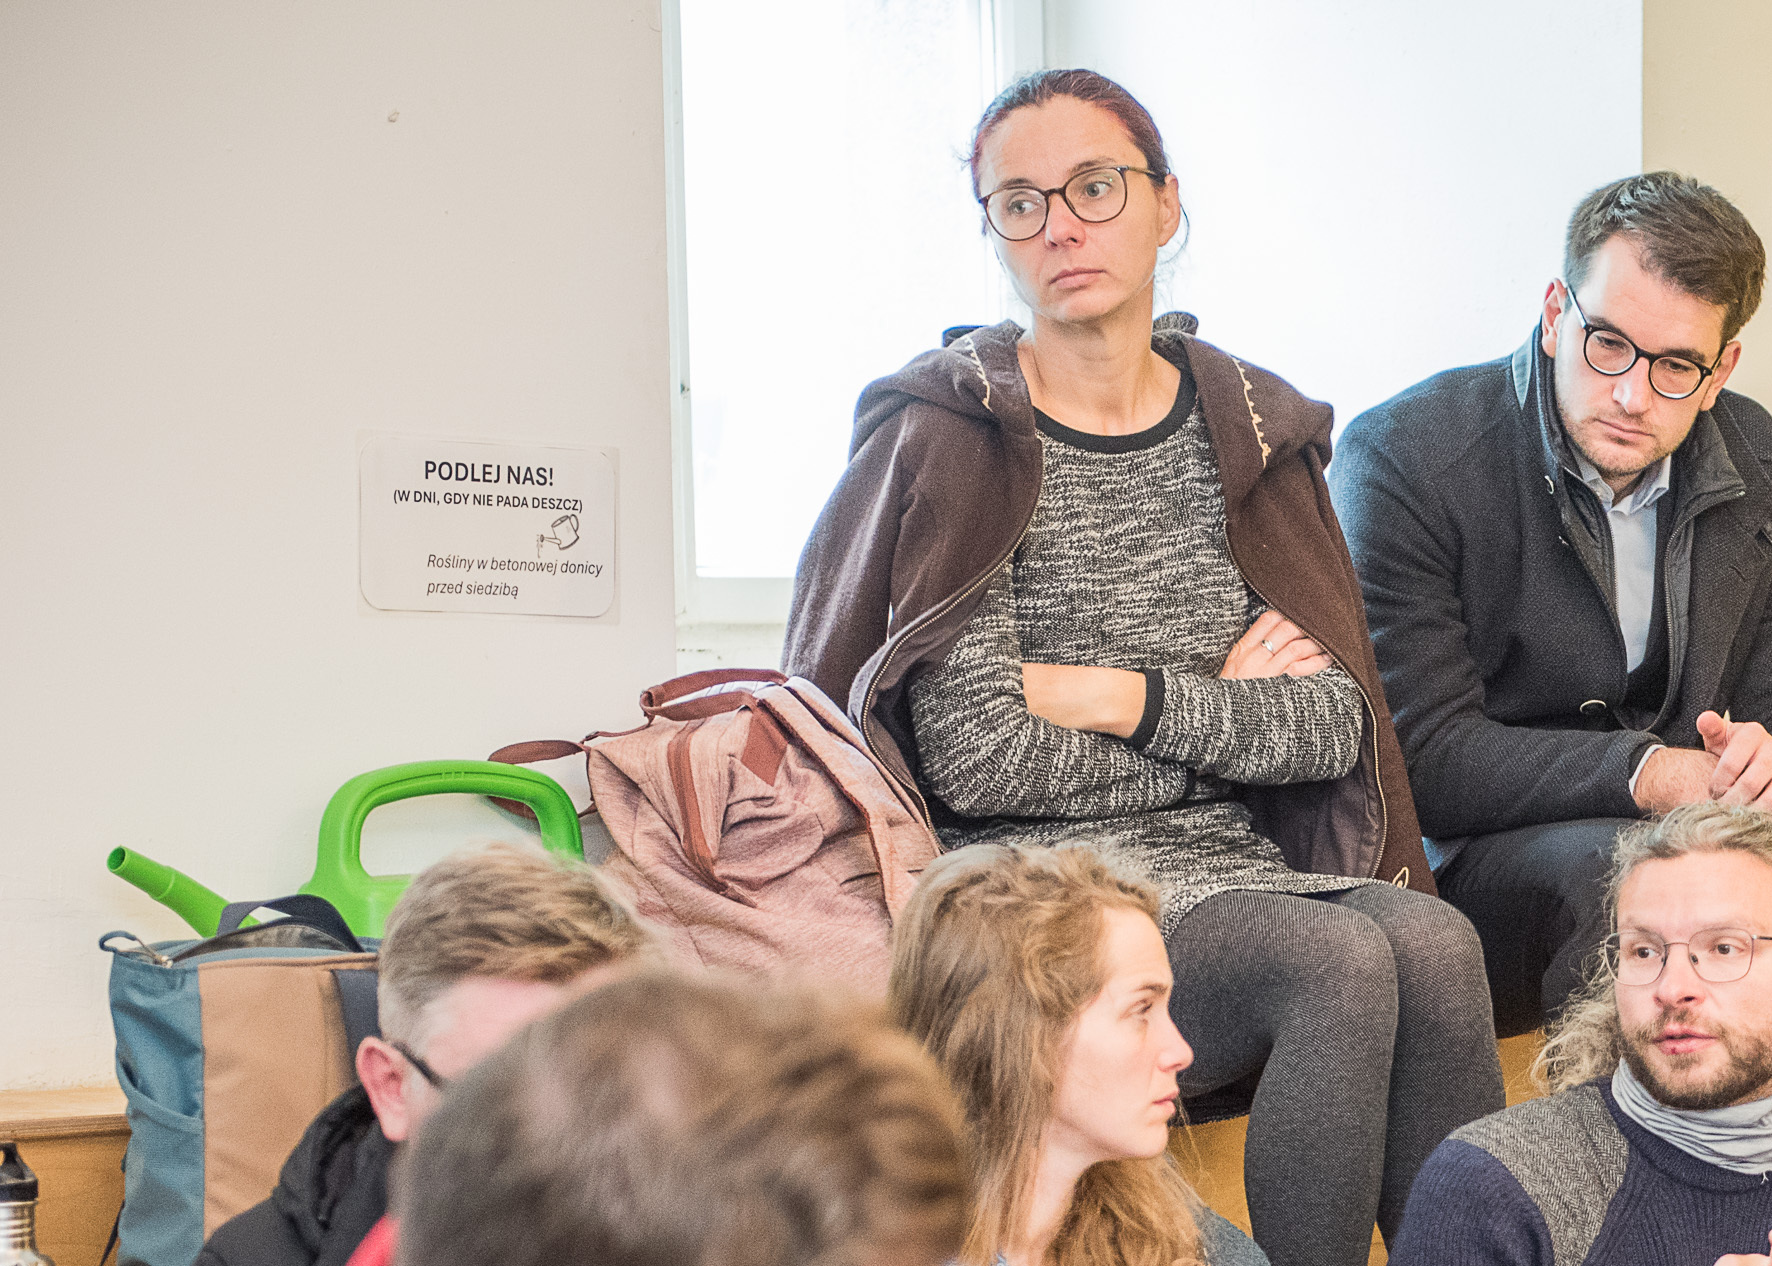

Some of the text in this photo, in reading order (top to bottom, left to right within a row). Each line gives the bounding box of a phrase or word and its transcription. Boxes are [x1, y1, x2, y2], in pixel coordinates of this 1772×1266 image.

[424, 460, 554, 486] PODLEJ NAS!
[393, 489, 583, 513] (W DNI, GDY NIE PADA DESZCZ)
[427, 554, 604, 577] Rośliny w betonowej donicy
[426, 581, 519, 599] przed siedzibą
